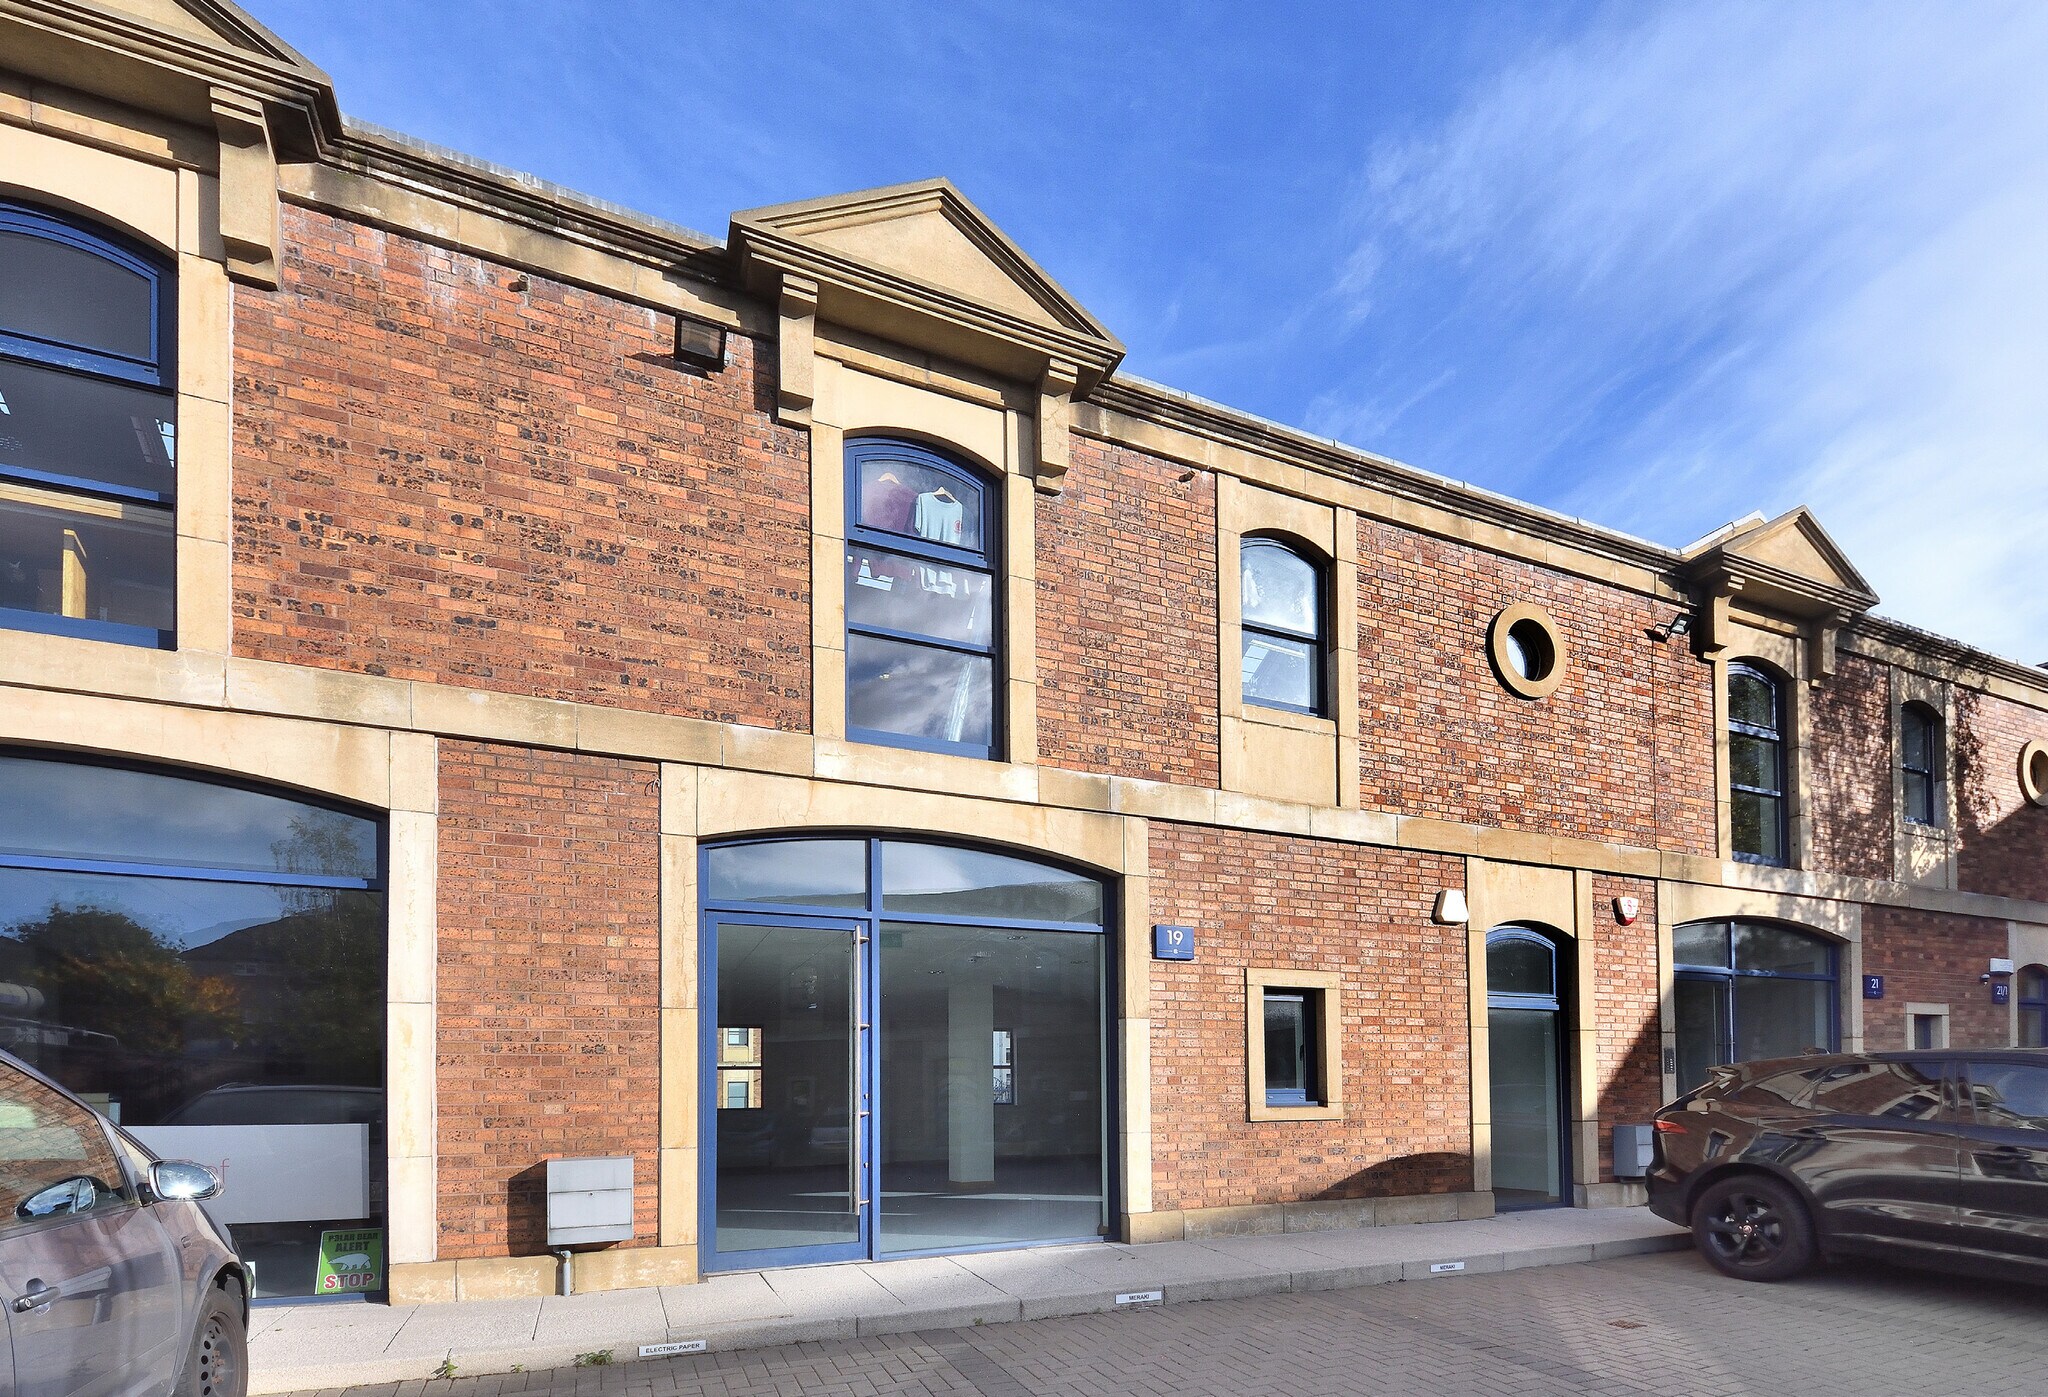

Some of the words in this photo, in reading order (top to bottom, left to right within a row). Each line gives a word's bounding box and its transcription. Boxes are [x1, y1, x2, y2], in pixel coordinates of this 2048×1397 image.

[1166, 929, 1184, 946] 19
[1870, 978, 1879, 989] 21
[1996, 985, 2008, 997] 21/1
[328, 1233, 355, 1242] POLAR
[357, 1232, 379, 1240] BEAR
[335, 1241, 370, 1252] ALERT
[324, 1272, 375, 1289] STOP
[645, 1345, 678, 1354] ELECTRIC
